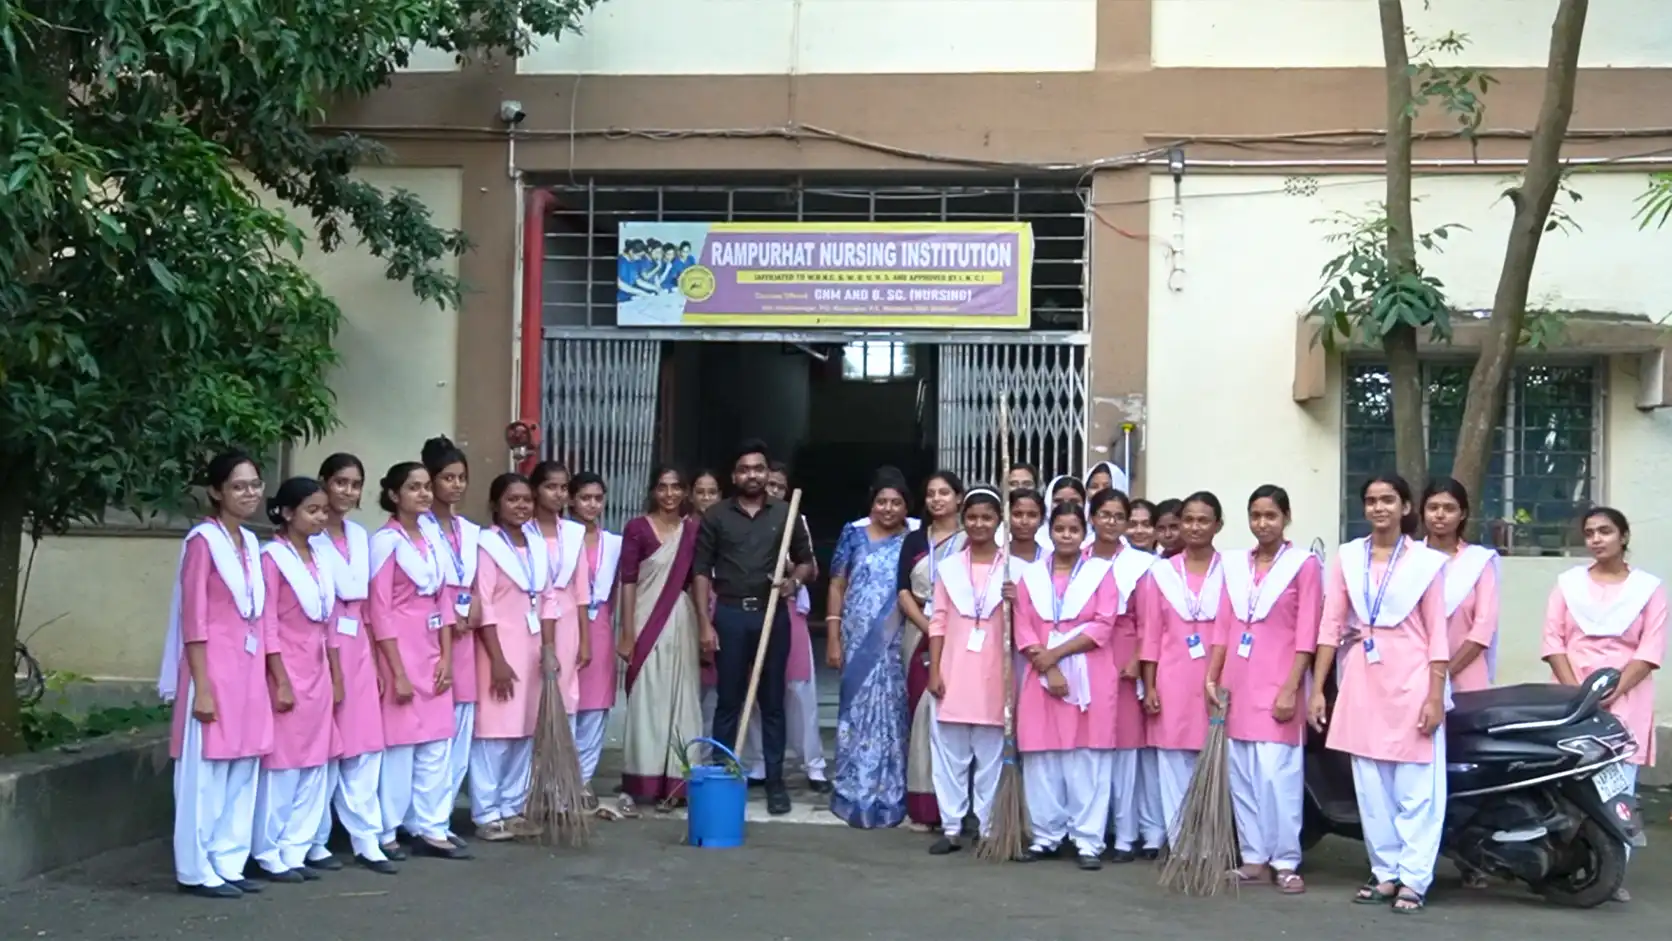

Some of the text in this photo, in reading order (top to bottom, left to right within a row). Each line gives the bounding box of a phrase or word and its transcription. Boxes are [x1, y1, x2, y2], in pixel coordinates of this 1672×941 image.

[711, 241, 1012, 268] RAMPURHAT NURSING INSTITUTION
[814, 288, 841, 301] GNM
[844, 288, 869, 301] AND
[909, 288, 972, 303] (NURSING)
